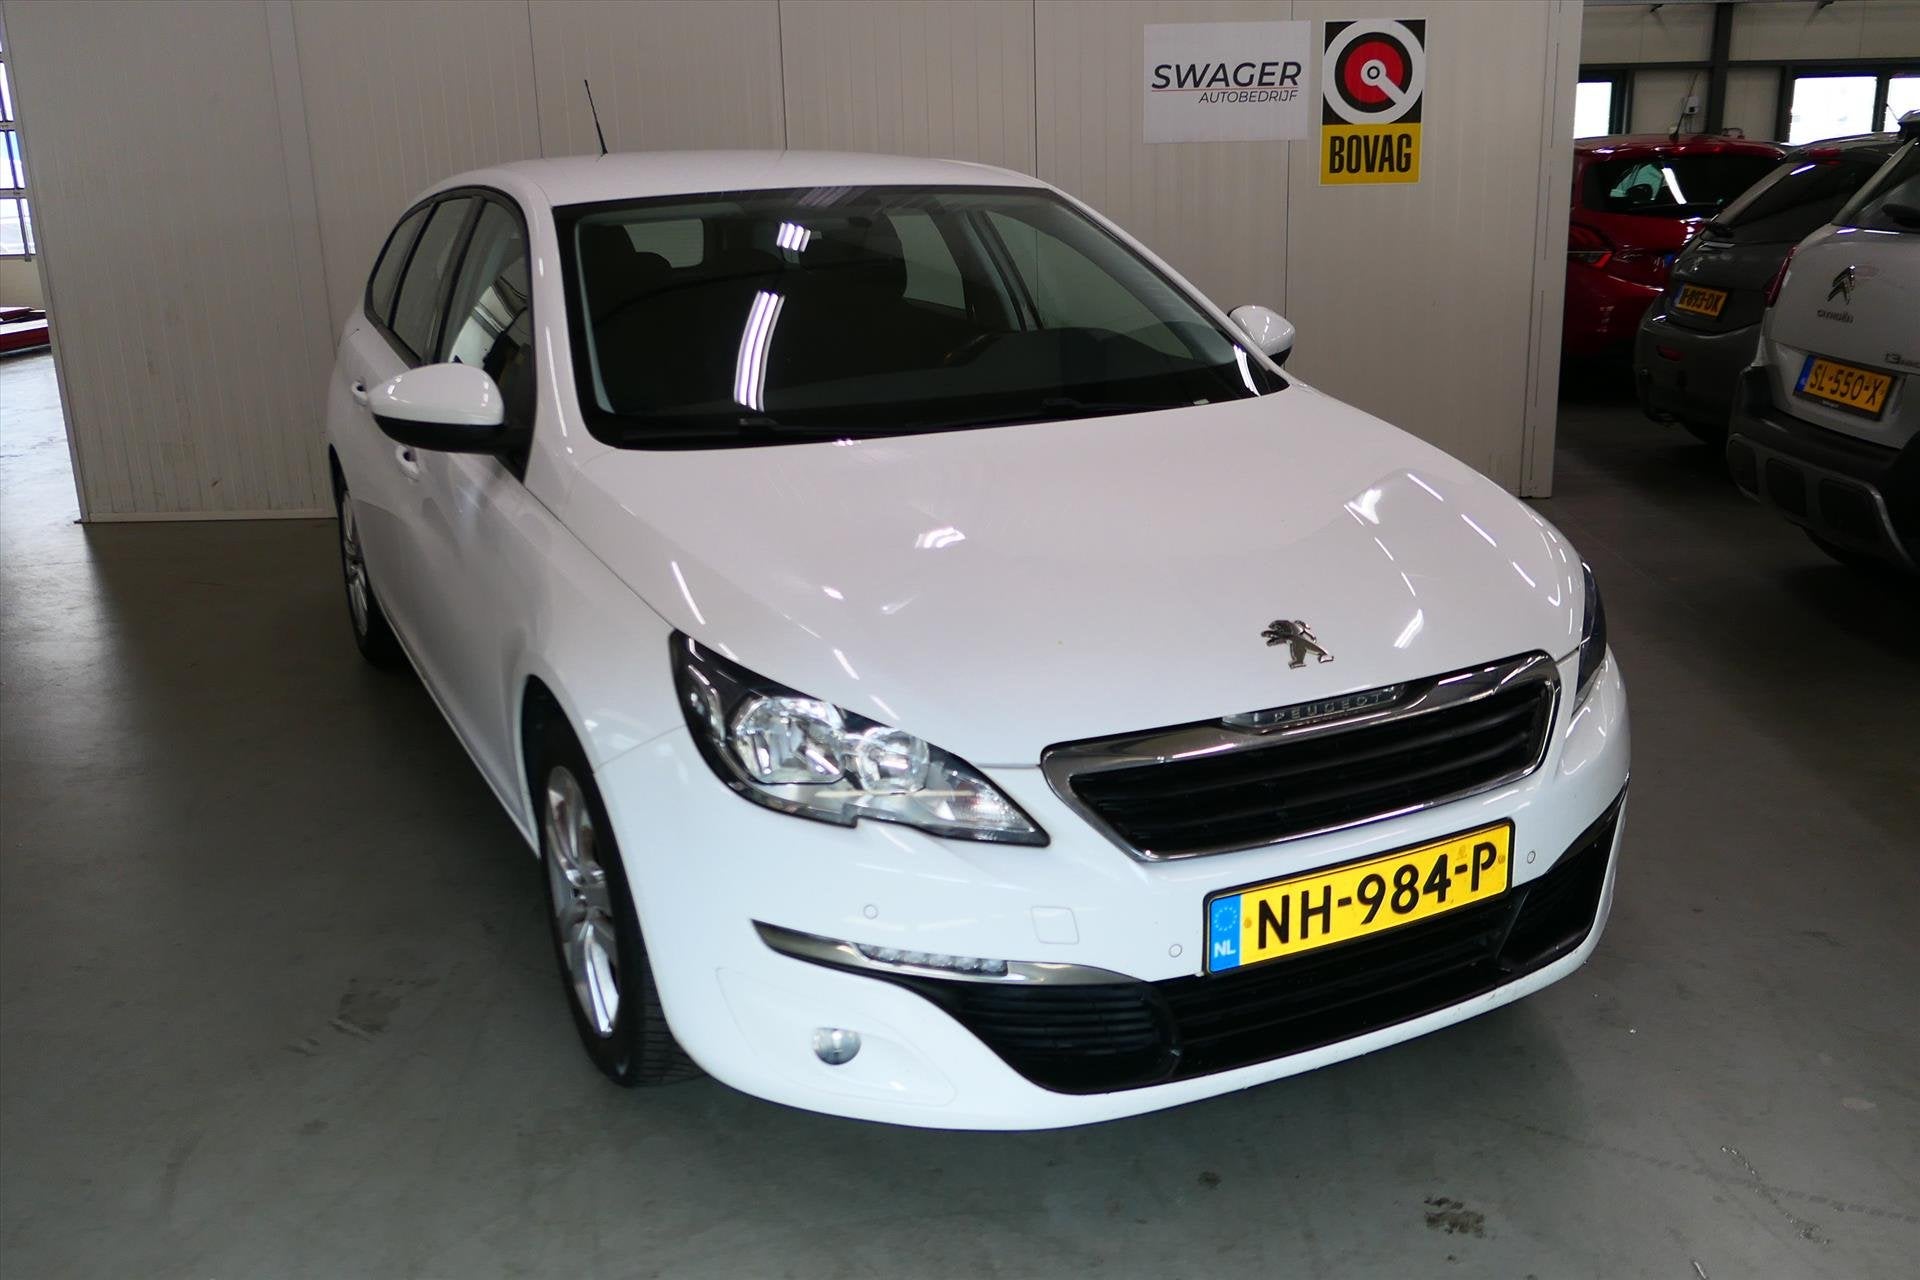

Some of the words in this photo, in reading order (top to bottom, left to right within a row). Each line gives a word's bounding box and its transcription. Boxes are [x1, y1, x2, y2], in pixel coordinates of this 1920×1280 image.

[1151, 61, 1302, 90] SWAGER
[1198, 89, 1298, 104] AUTOBEDRIJF
[1328, 133, 1412, 174] BOVAG
[1808, 363, 1885, 407] SL-550-X
[1273, 693, 1381, 722] PEUGEOT
[1257, 840, 1498, 950] NH-984-P
[1213, 938, 1237, 958] NL
